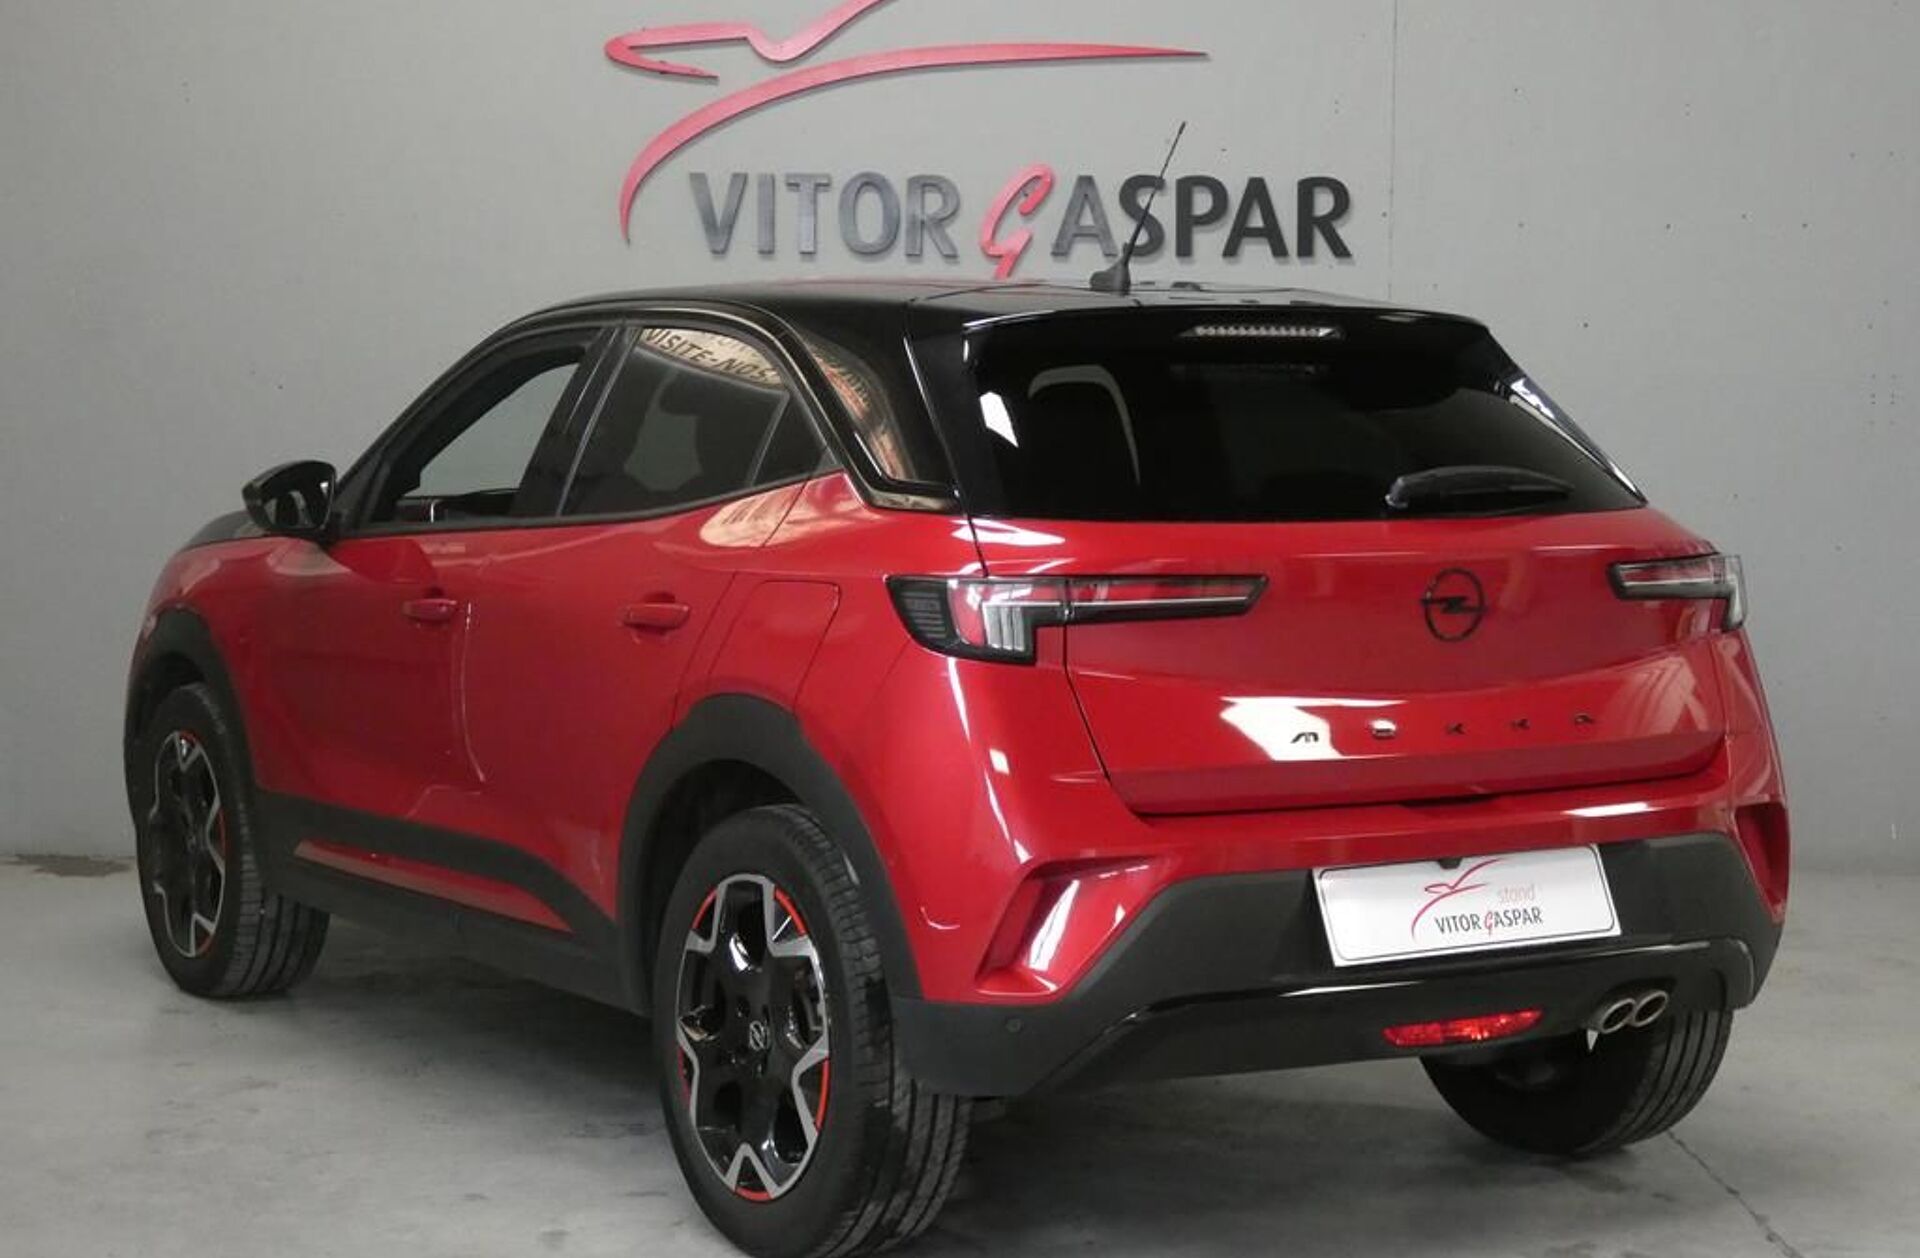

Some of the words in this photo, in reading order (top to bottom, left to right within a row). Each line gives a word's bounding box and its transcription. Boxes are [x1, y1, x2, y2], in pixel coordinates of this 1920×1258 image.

[688, 172, 961, 259] VITOR
[980, 163, 1353, 279] GASPAR
[1290, 712, 1596, 744] MOKKA
[1498, 884, 1536, 904] stand
[1435, 912, 1481, 935] VITOR
[1484, 906, 1543, 936] GASPAR
